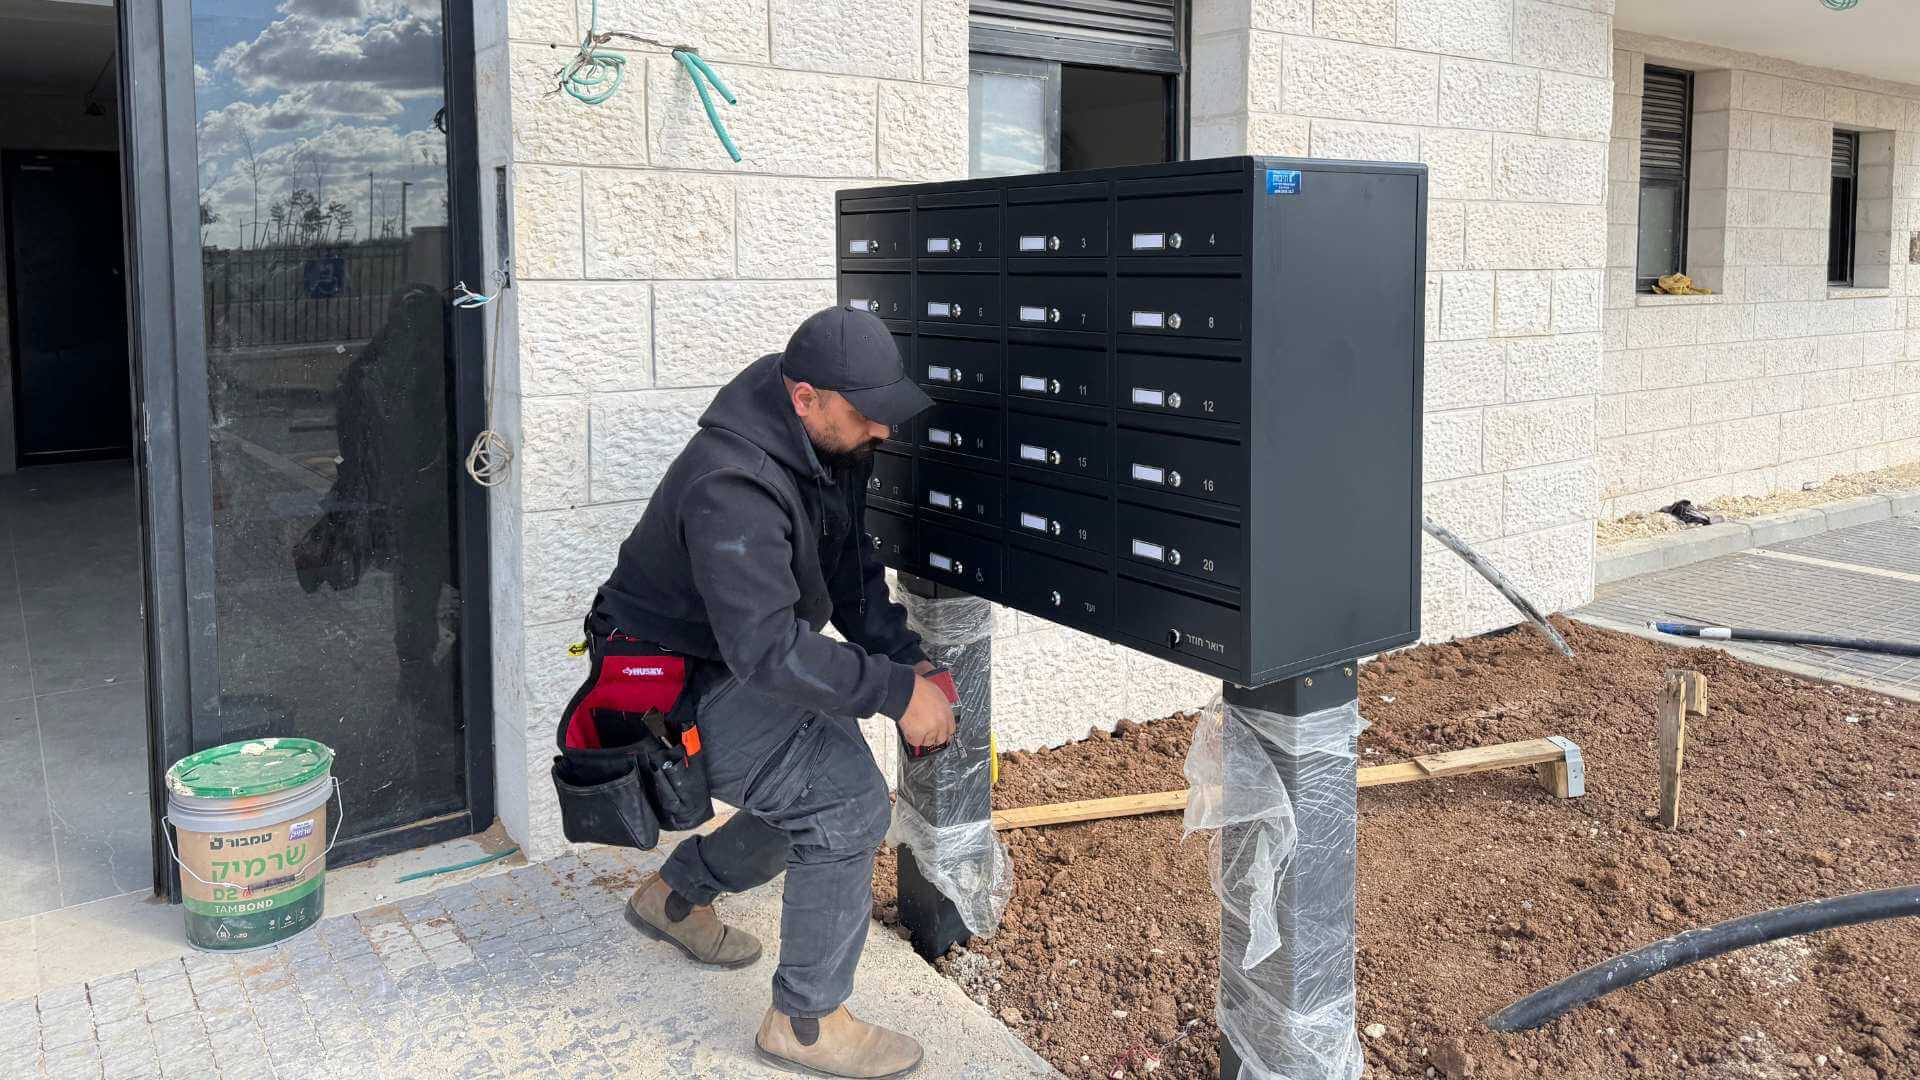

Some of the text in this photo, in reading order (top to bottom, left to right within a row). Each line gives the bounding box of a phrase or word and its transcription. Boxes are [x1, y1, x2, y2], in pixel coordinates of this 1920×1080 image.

[1203, 400, 1213, 412] 12
[1077, 457, 1087, 467] 15
[1204, 480, 1213, 491] 16
[1204, 559, 1213, 571] 20
[1186, 633, 1225, 655] דואר חוזר
[631, 667, 663, 676] HUSKY
[225, 832, 272, 848] טמבור
[211, 844, 306, 882] שרמיק
[213, 887, 238, 900] D2
[215, 899, 273, 913] TAMBOND
